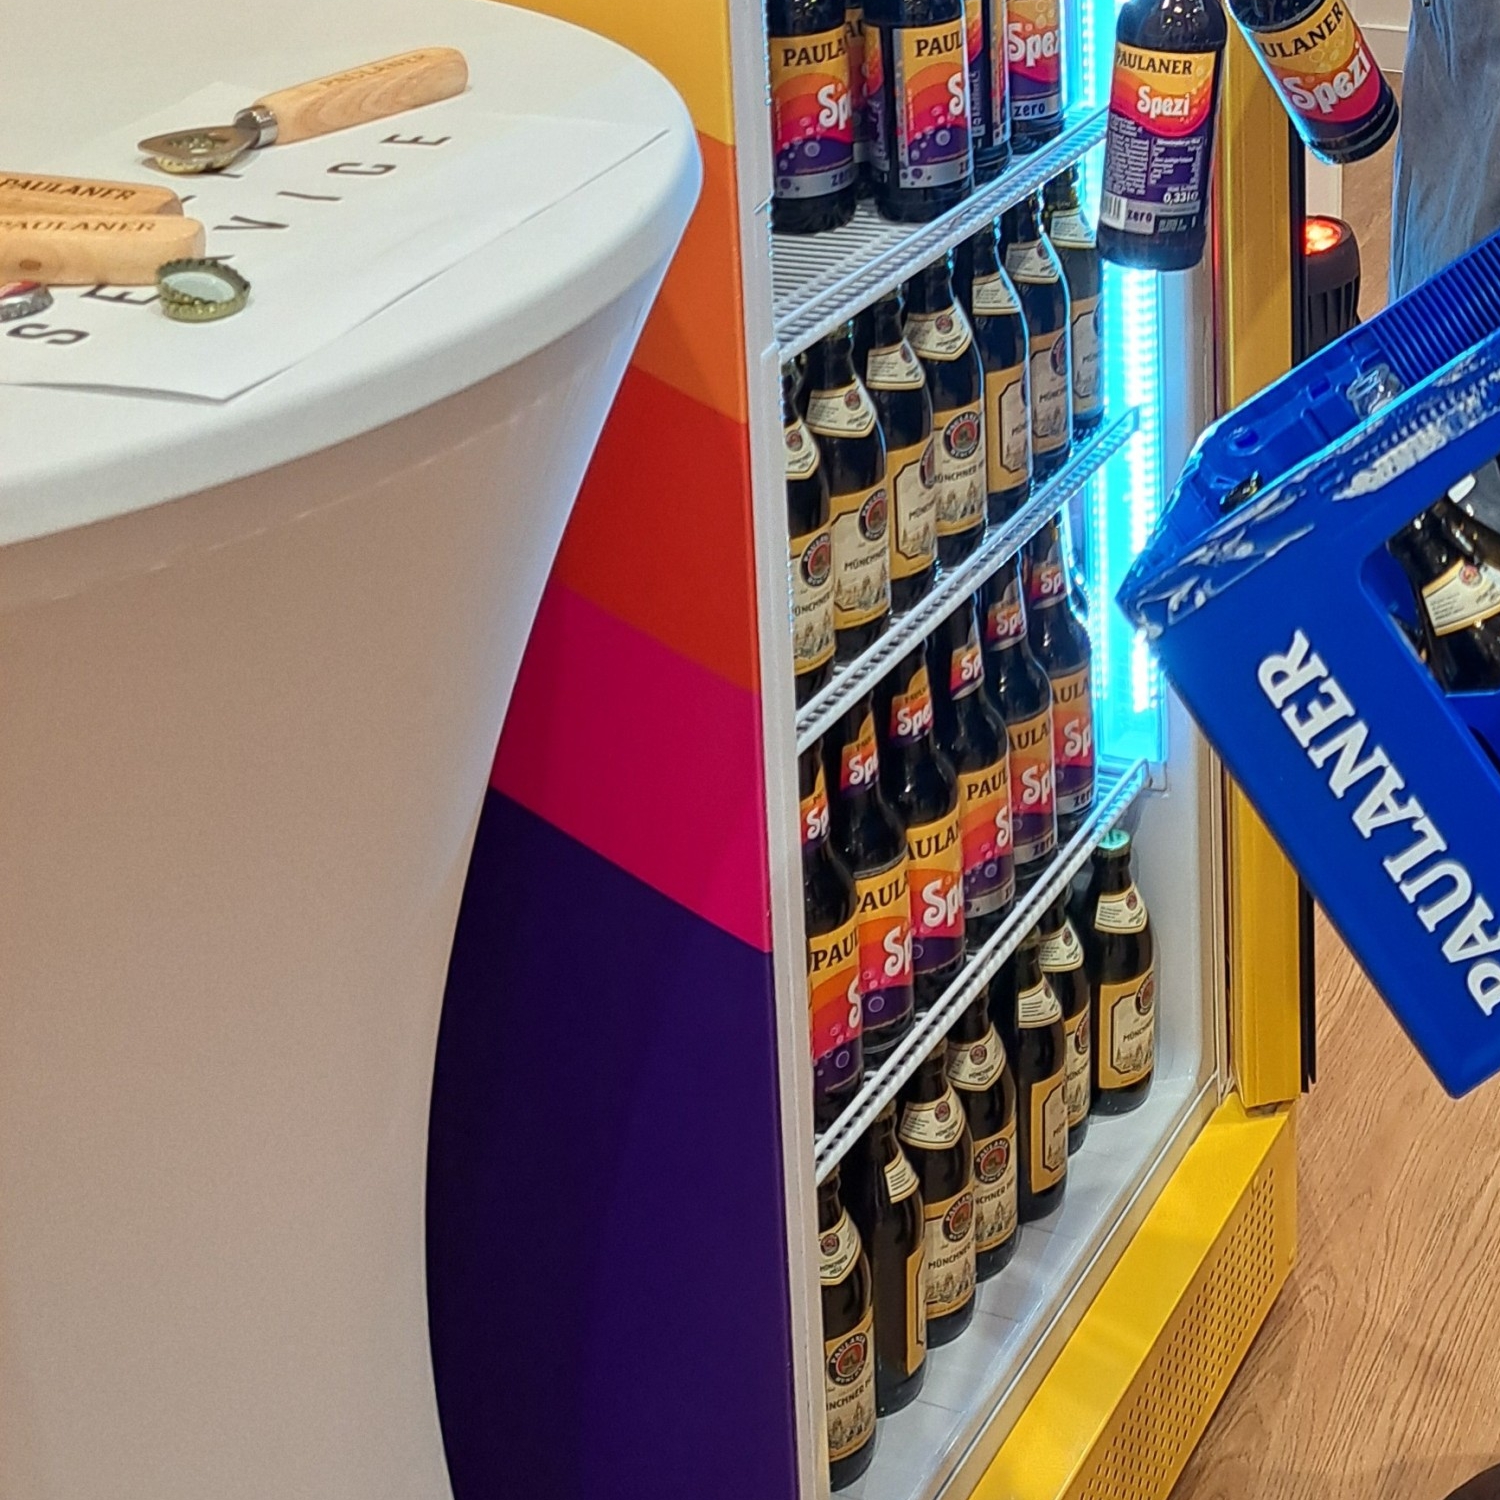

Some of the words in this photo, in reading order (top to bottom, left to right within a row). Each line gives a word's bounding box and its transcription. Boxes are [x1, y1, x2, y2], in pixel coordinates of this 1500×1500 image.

[1282, 40, 1372, 115] Spezi
[1014, 100, 1046, 118] zero
[1136, 85, 1191, 120] Spezi
[0, 177, 138, 201] PAULANER
[1127, 207, 1153, 224] zero
